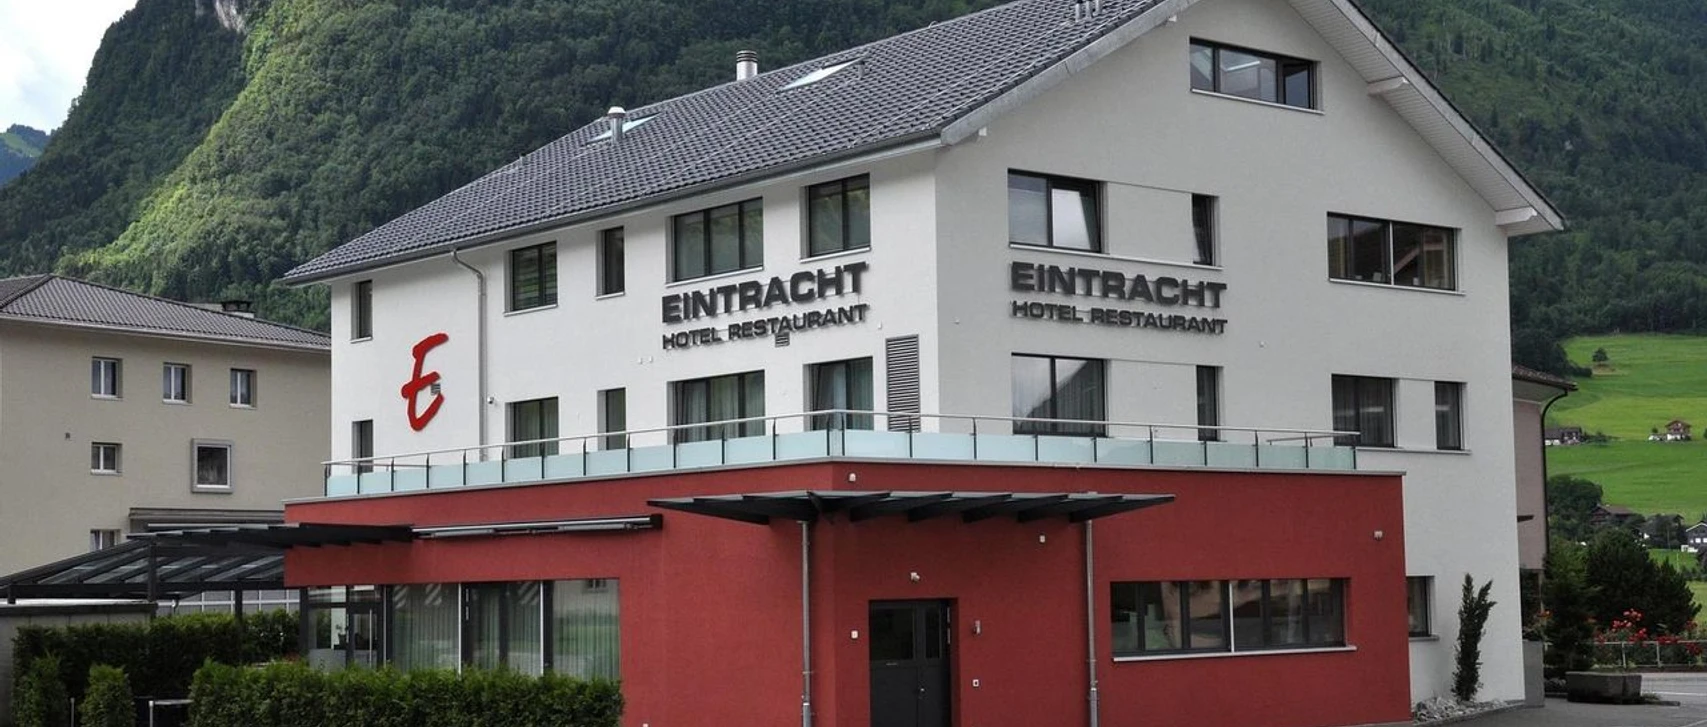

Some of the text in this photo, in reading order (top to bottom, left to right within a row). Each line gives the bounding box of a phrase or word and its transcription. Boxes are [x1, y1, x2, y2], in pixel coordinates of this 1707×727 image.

[662, 261, 868, 323] EINTRACHT
[1010, 261, 1228, 308] EINTRACHT
[663, 303, 868, 349] HOTEL RESTAURANT
[1012, 300, 1228, 334] HOTEL RESTAURANT
